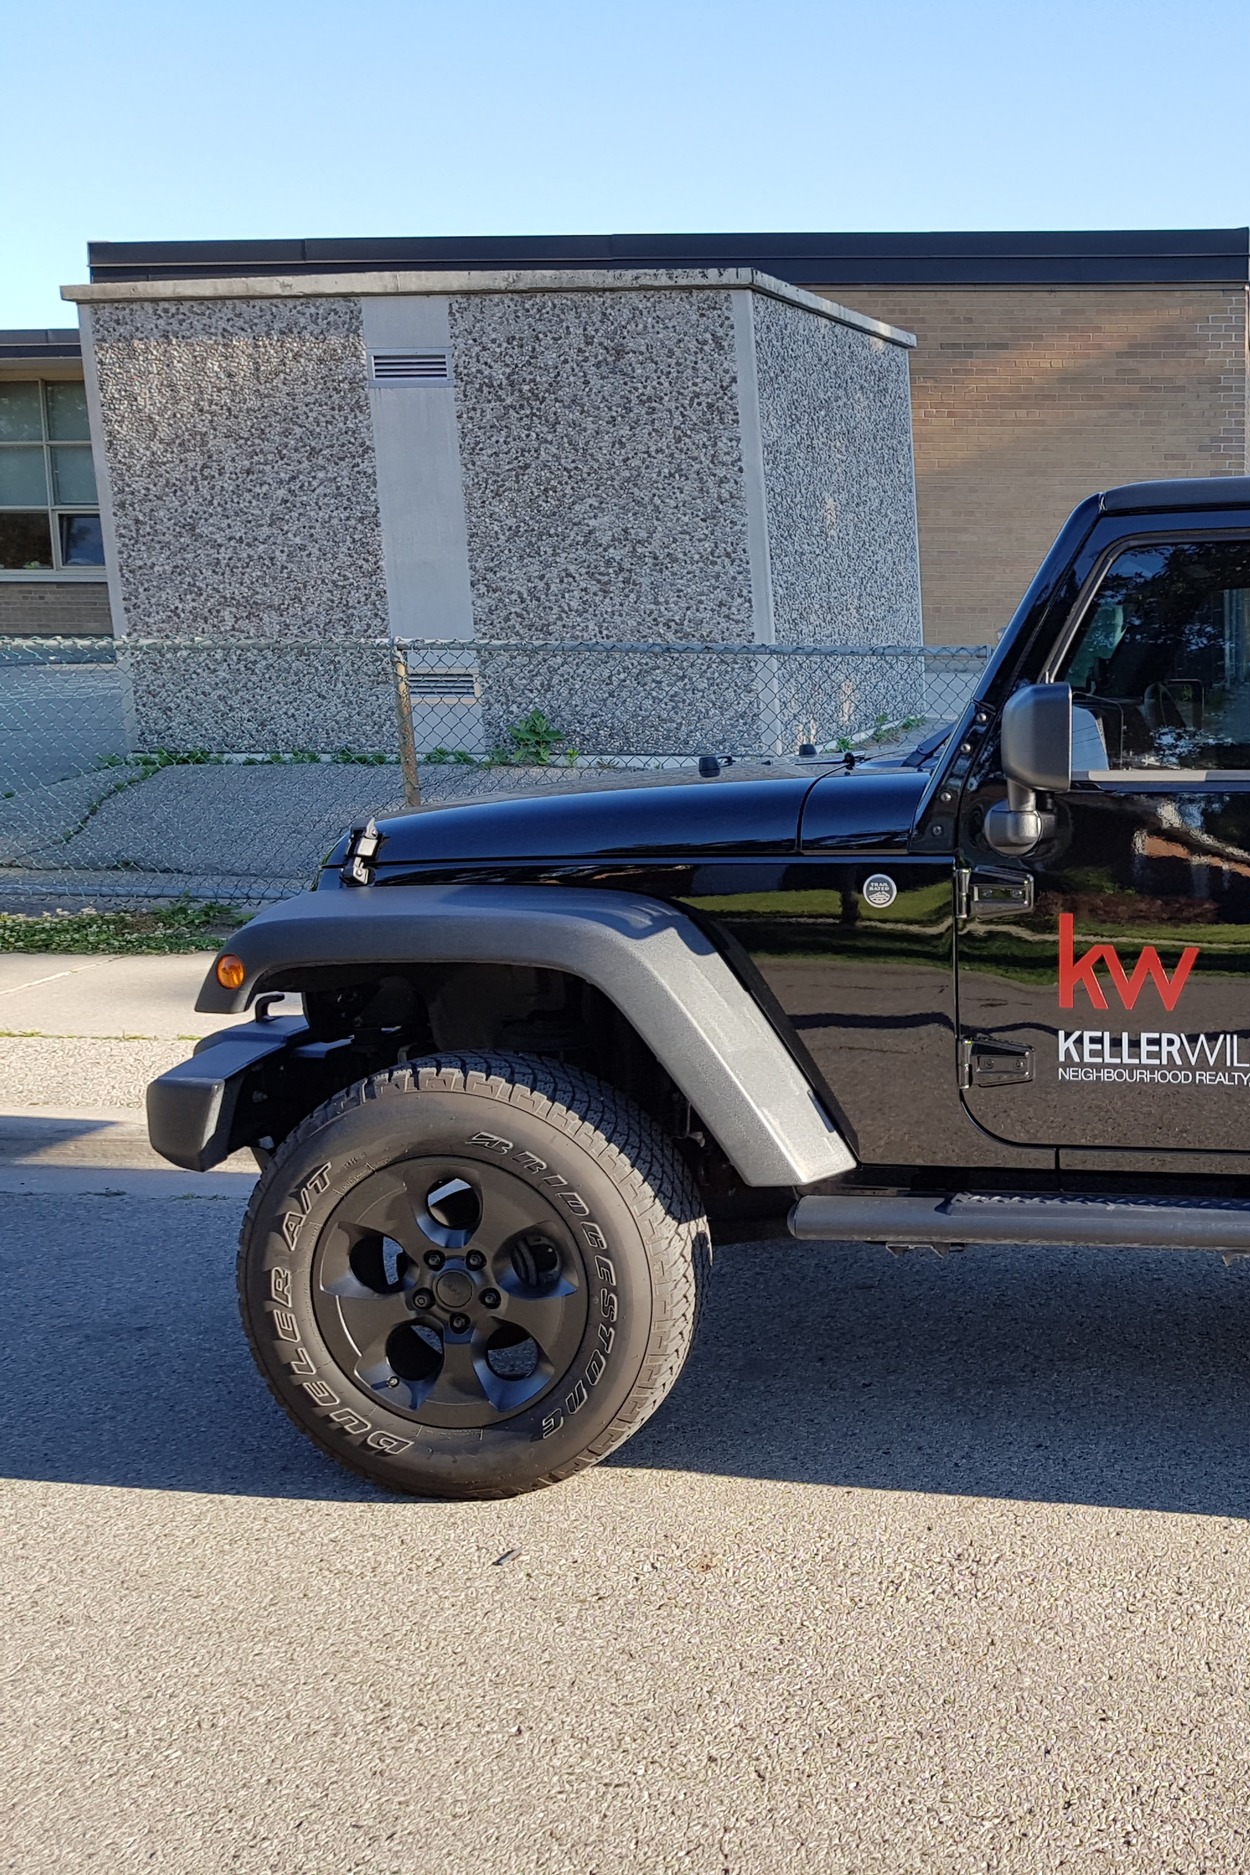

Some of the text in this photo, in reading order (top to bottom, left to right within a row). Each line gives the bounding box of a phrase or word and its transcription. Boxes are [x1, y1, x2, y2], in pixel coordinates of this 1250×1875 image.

[1058, 1067, 1192, 1085] NEIGHBOURHOOD
[271, 1266, 415, 1456] DUELER
[466, 1131, 618, 1441] BRIDGESTONE
